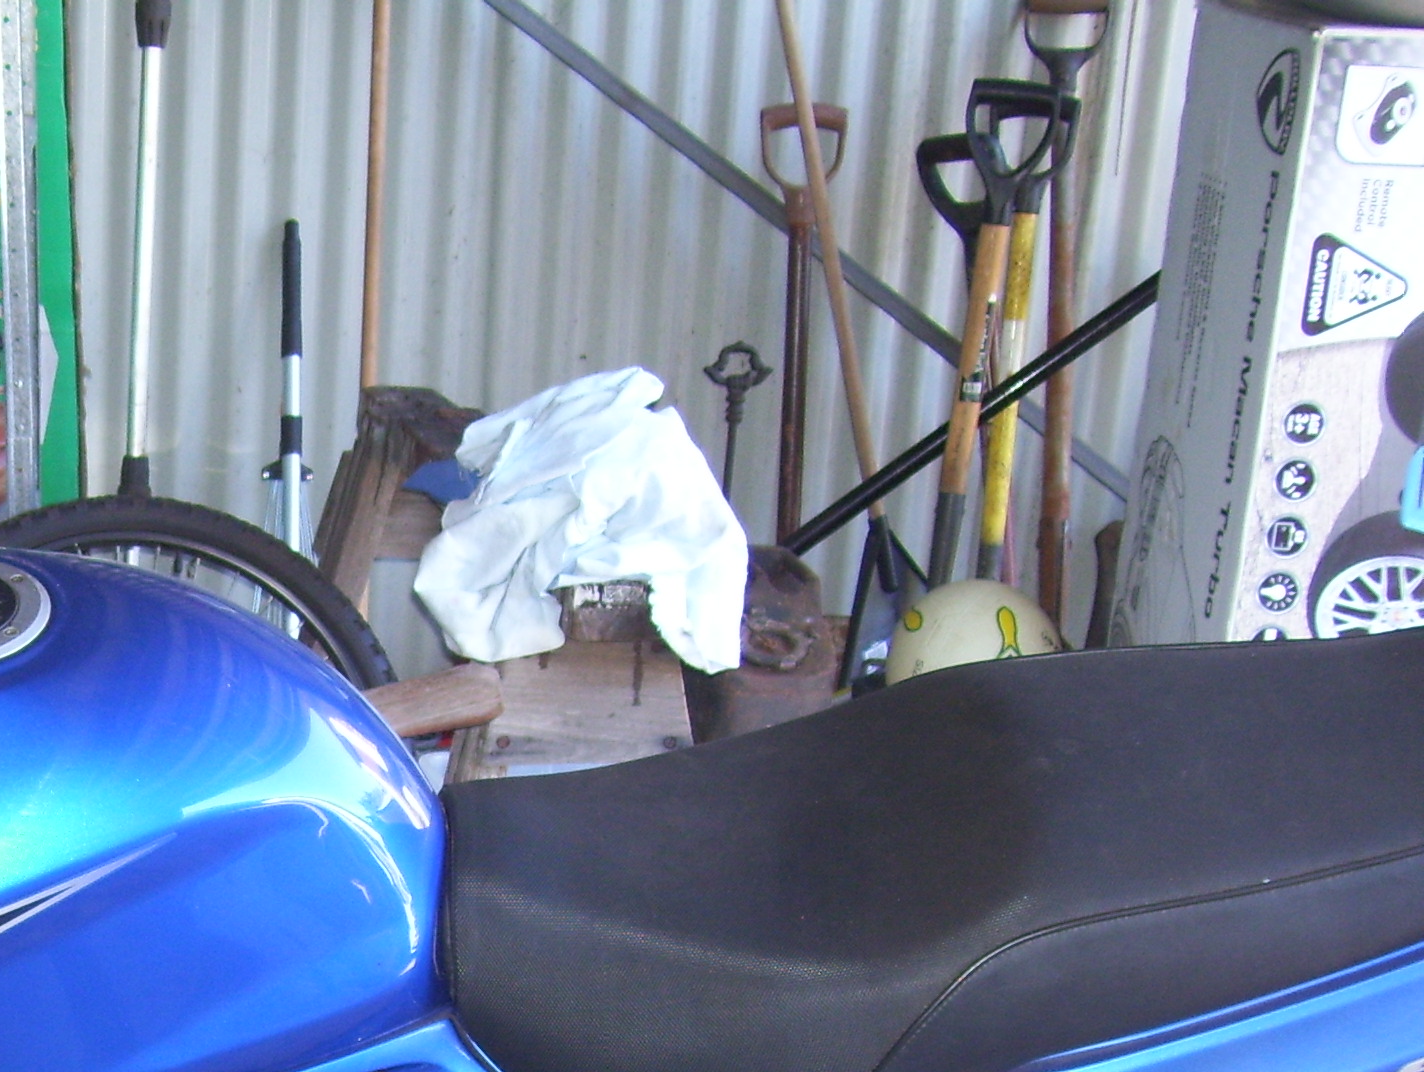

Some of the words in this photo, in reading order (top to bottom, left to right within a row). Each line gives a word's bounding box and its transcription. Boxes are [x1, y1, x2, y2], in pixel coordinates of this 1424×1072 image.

[1354, 178, 1371, 232] Included
[1366, 179, 1383, 226] Control
[1378, 179, 1394, 228] Remote
[1245, 170, 1282, 342] Porsche
[1306, 248, 1330, 322] CAUTION
[1223, 356, 1255, 486] Macan
[1203, 500, 1232, 620] Turbo
